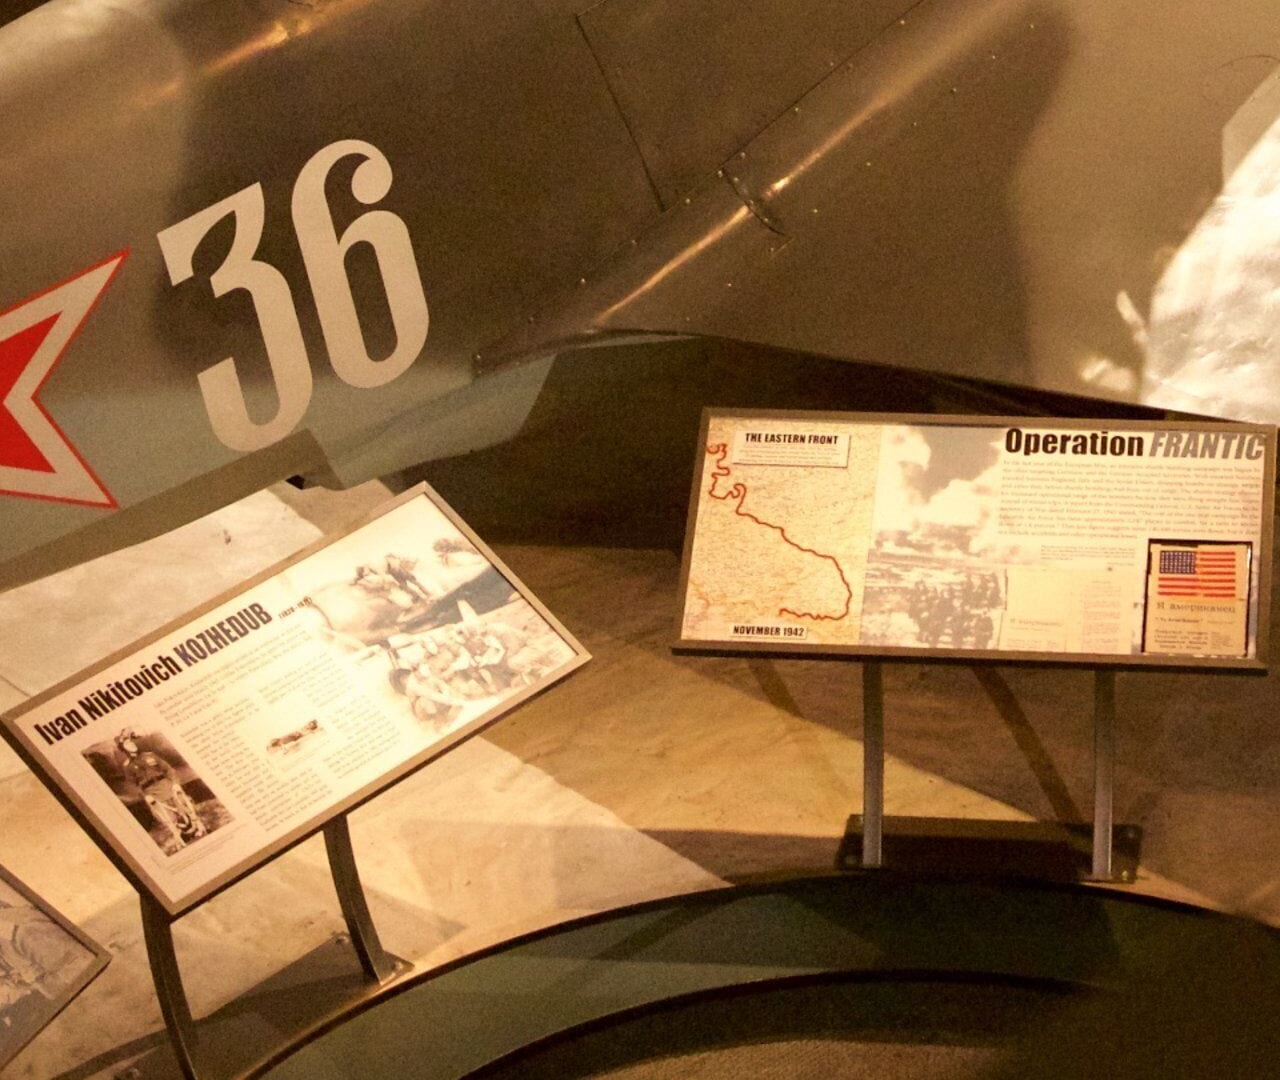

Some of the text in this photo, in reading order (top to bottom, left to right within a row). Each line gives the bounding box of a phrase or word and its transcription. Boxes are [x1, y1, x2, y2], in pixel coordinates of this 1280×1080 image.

[156, 138, 430, 452] 36
[745, 432, 838, 445] THE EASTERN FRONT
[1005, 427, 1266, 461] Operation FRANTIC
[733, 625, 805, 637] NOVEMBER 1942
[33, 707, 88, 746] Ivan
[77, 655, 183, 722] Nikitovich
[173, 602, 273, 668] KOZHEDUB
